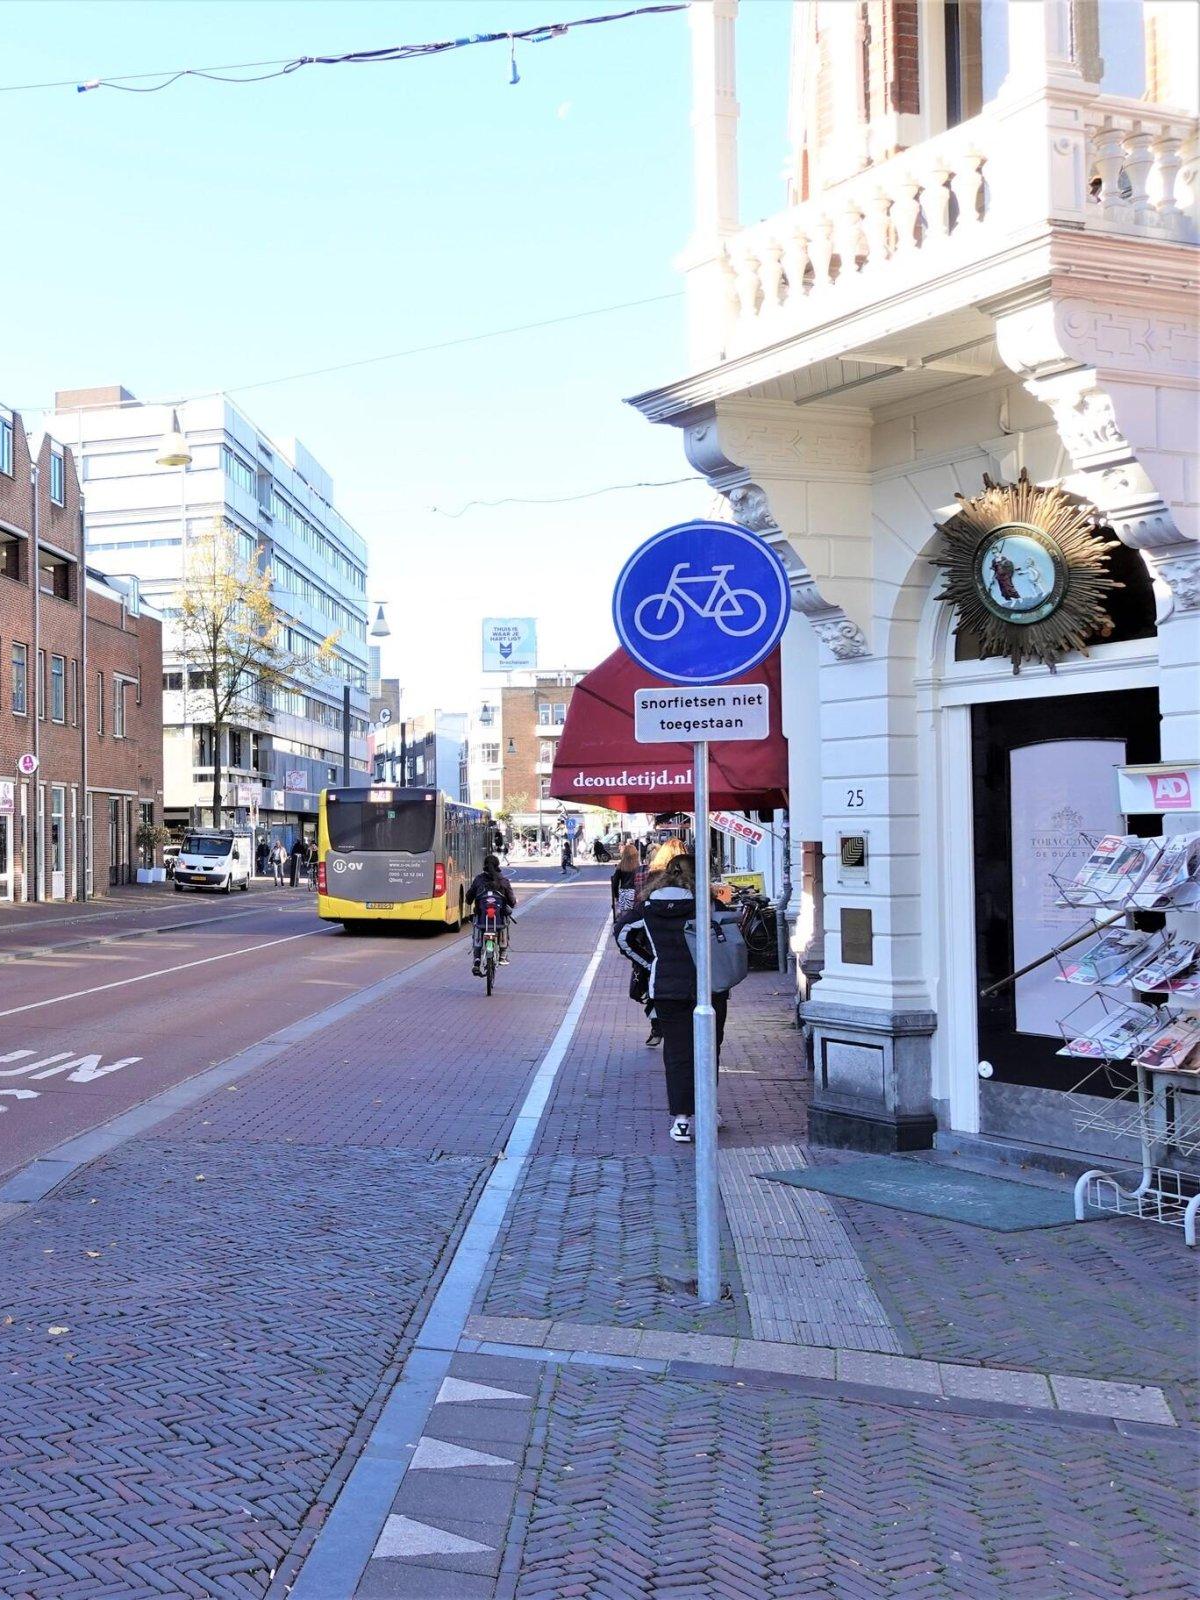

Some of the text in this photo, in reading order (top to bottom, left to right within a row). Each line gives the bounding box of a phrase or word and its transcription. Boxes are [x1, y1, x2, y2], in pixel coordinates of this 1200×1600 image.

[641, 694, 763, 709] snorfietsen niet
[660, 717, 744, 732] toegestaan
[573, 770, 692, 790] deoudetijd.nl
[1155, 777, 1188, 799] AD
[847, 790, 864, 807] 25
